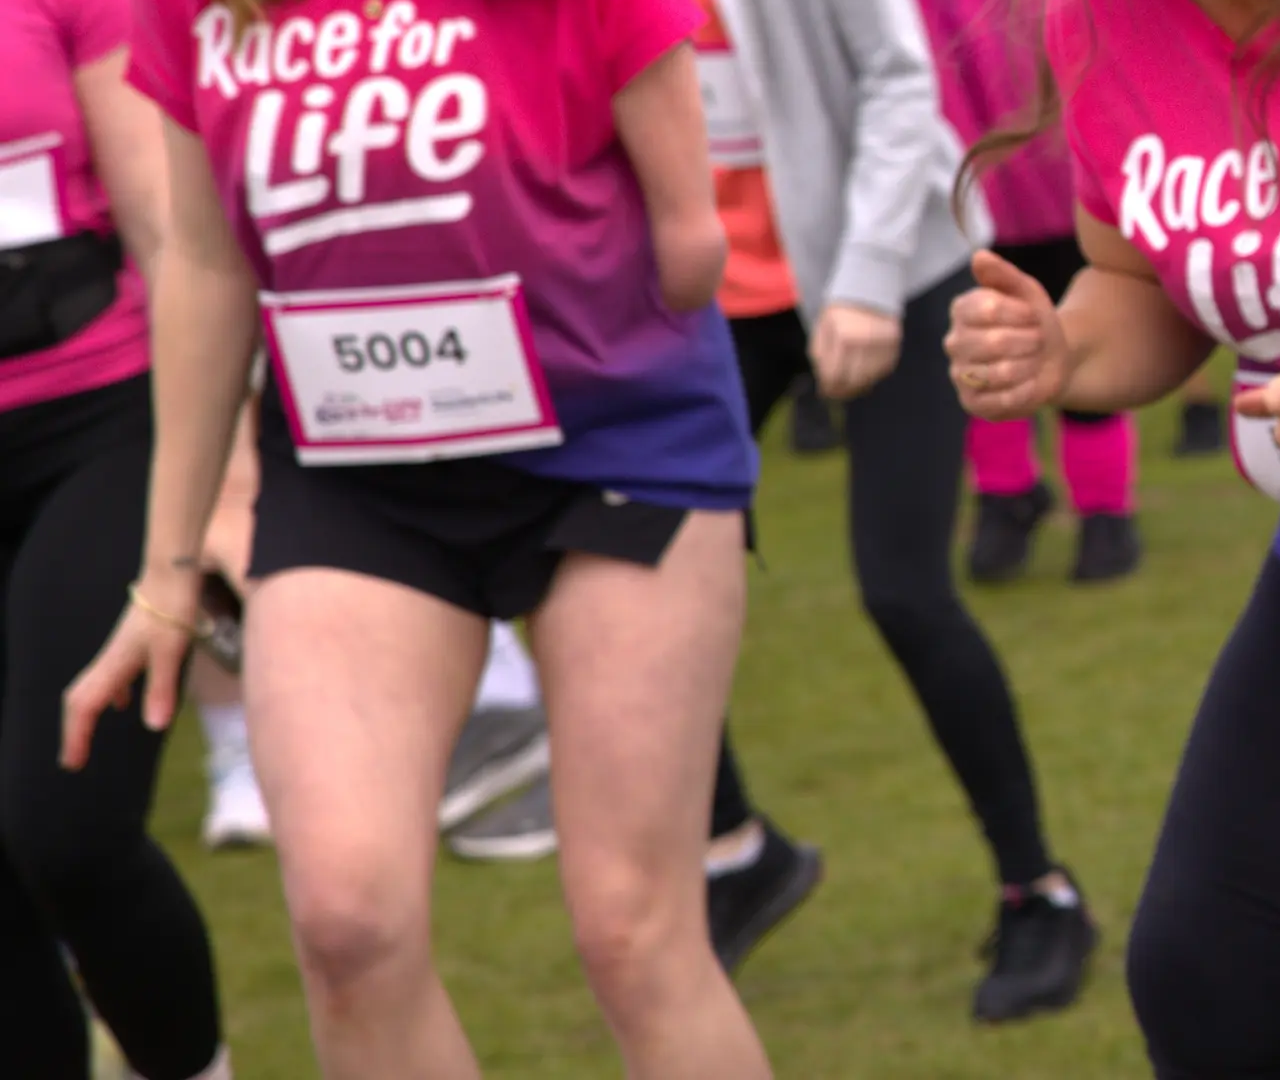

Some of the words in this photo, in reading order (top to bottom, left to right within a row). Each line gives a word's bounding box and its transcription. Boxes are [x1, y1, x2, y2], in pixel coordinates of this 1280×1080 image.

[193, 2, 362, 98] Race
[245, 71, 489, 218] Life
[1119, 132, 1280, 252] Race
[332, 324, 468, 374] 5004
